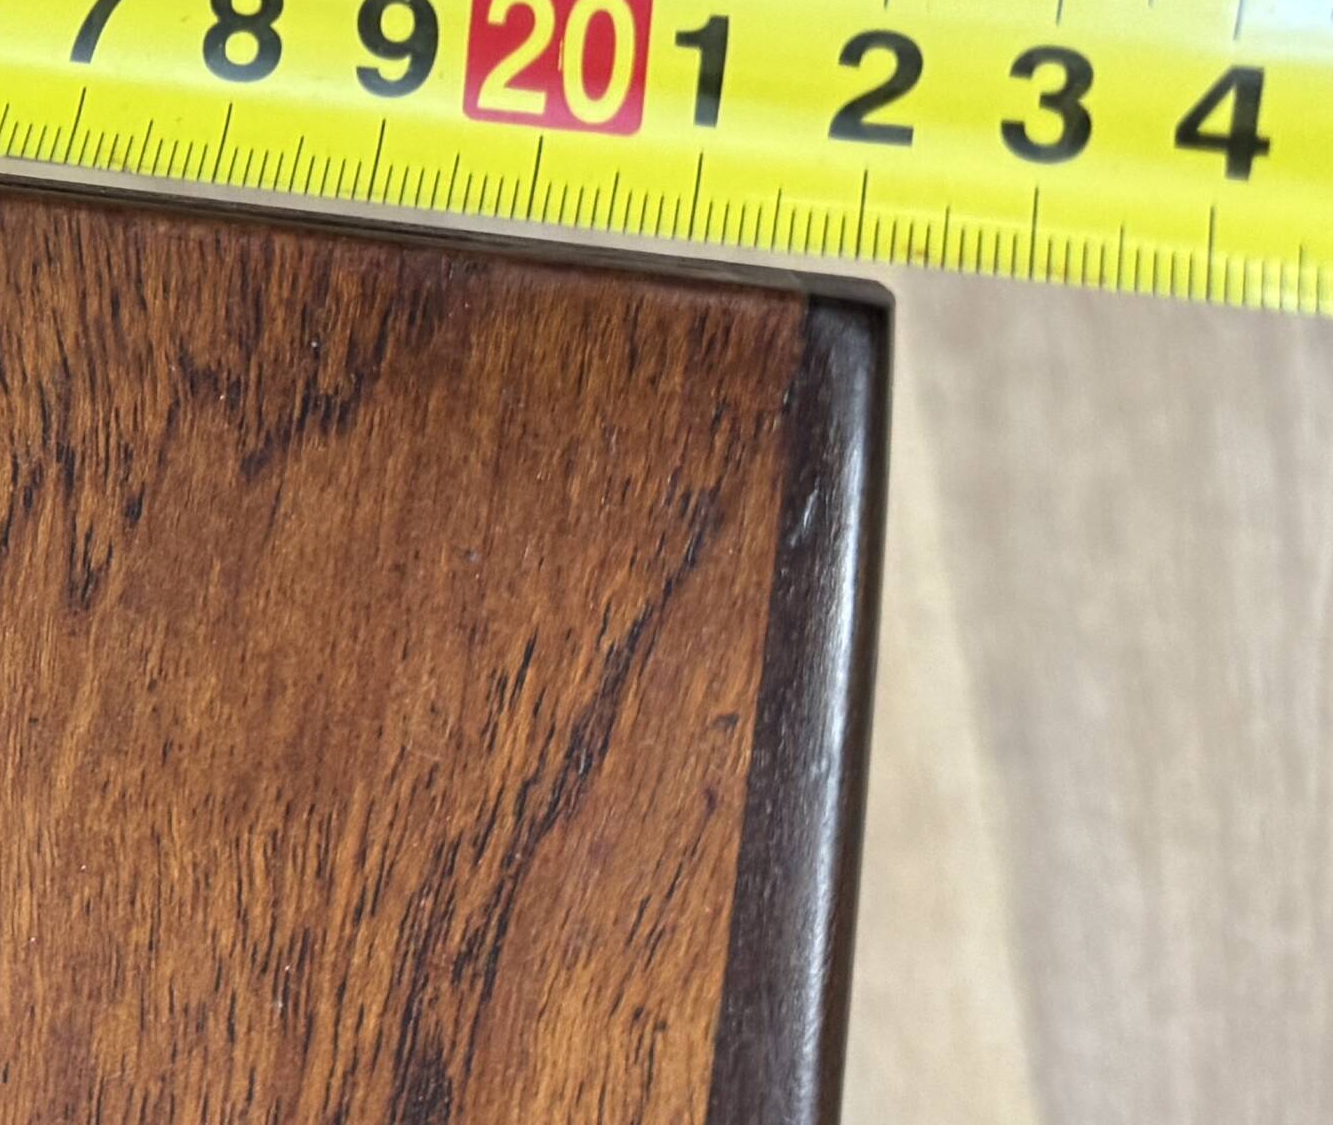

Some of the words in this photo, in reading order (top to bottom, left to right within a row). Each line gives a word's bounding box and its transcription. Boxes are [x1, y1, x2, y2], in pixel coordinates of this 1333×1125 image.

[676, 16, 728, 124] 1
[831, 31, 922, 142] 2
[1002, 47, 1093, 161] 3
[1176, 69, 1270, 177] 4
